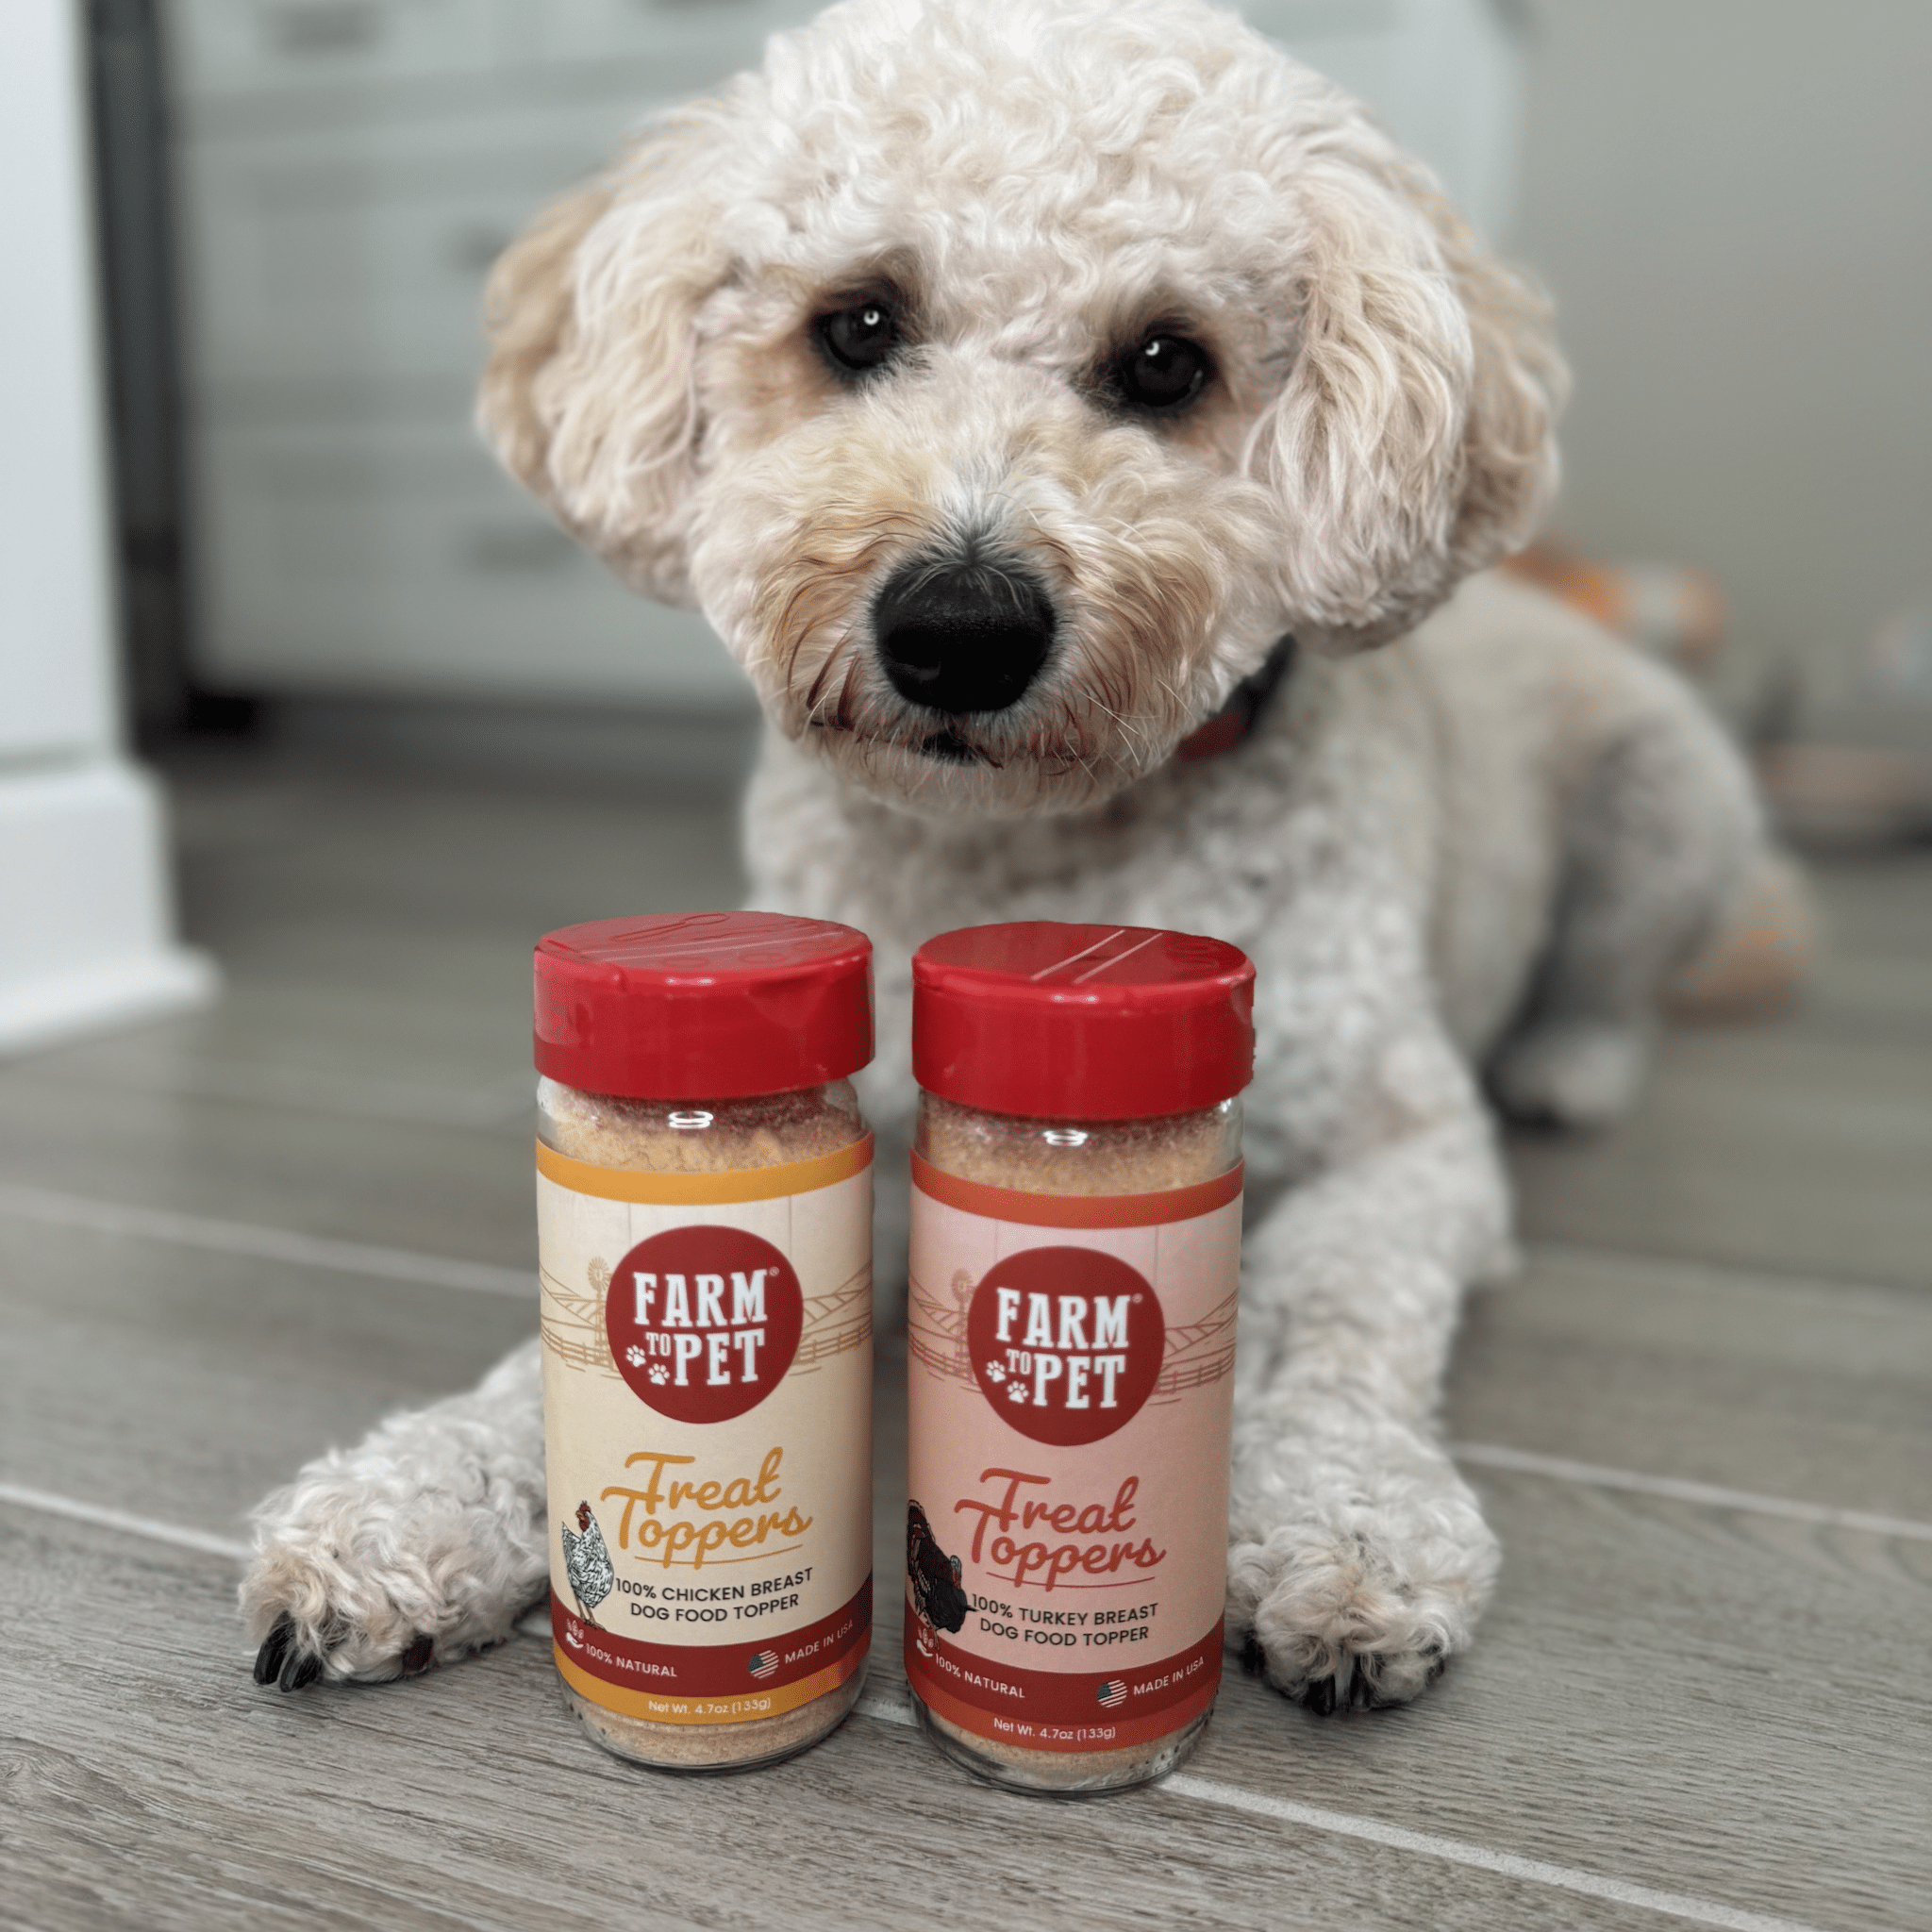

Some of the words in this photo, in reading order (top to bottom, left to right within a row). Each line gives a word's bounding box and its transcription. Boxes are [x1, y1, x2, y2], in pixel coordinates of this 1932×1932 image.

[646, 1331, 671, 1356] TO
[675, 1328, 765, 1386] PET
[1006, 1348, 1031, 1374] TO
[1033, 1354, 1125, 1408] PET
[625, 1446, 783, 1515] Treat
[979, 1468, 1139, 1534] Treat
[601, 1487, 812, 1570] Toppers
[954, 1499, 1166, 1591] Toppers
[616, 1578, 657, 1599] 100%
[661, 1585, 744, 1602] CHICKEN
[751, 1567, 813, 1596] BREAST
[630, 1603, 670, 1620] DOG
[675, 1608, 727, 1622] FOOD
[733, 1593, 799, 1620] TOPPER
[972, 1593, 1013, 1618] 100%
[1019, 1607, 1088, 1625] TURKEY
[1093, 1603, 1158, 1624] BREAST
[785, 1641, 820, 1664] MADE
[823, 1634, 834, 1648] IN
[837, 1619, 853, 1639] USA
[980, 1618, 1018, 1640] DOG
[1024, 1630, 1076, 1646] FOOD
[1083, 1626, 1149, 1646] TOPPER
[586, 1642, 613, 1664] 100%
[616, 1656, 677, 1677] NATURAL
[936, 1653, 961, 1678] 100%
[964, 1671, 1025, 1698] NATURAL
[1133, 1675, 1169, 1696] MADE
[1172, 1669, 1184, 1683] IN
[1186, 1656, 1204, 1675] USA
[648, 1700, 670, 1712] Net
[694, 1703, 728, 1714] 4.7oz
[731, 1697, 771, 1714] (133g)
[993, 1718, 1013, 1733] Net
[1017, 1724, 1036, 1737] Wt.
[1039, 1728, 1074, 1740] 4.7oz
[1076, 1727, 1116, 1741] (133g)
